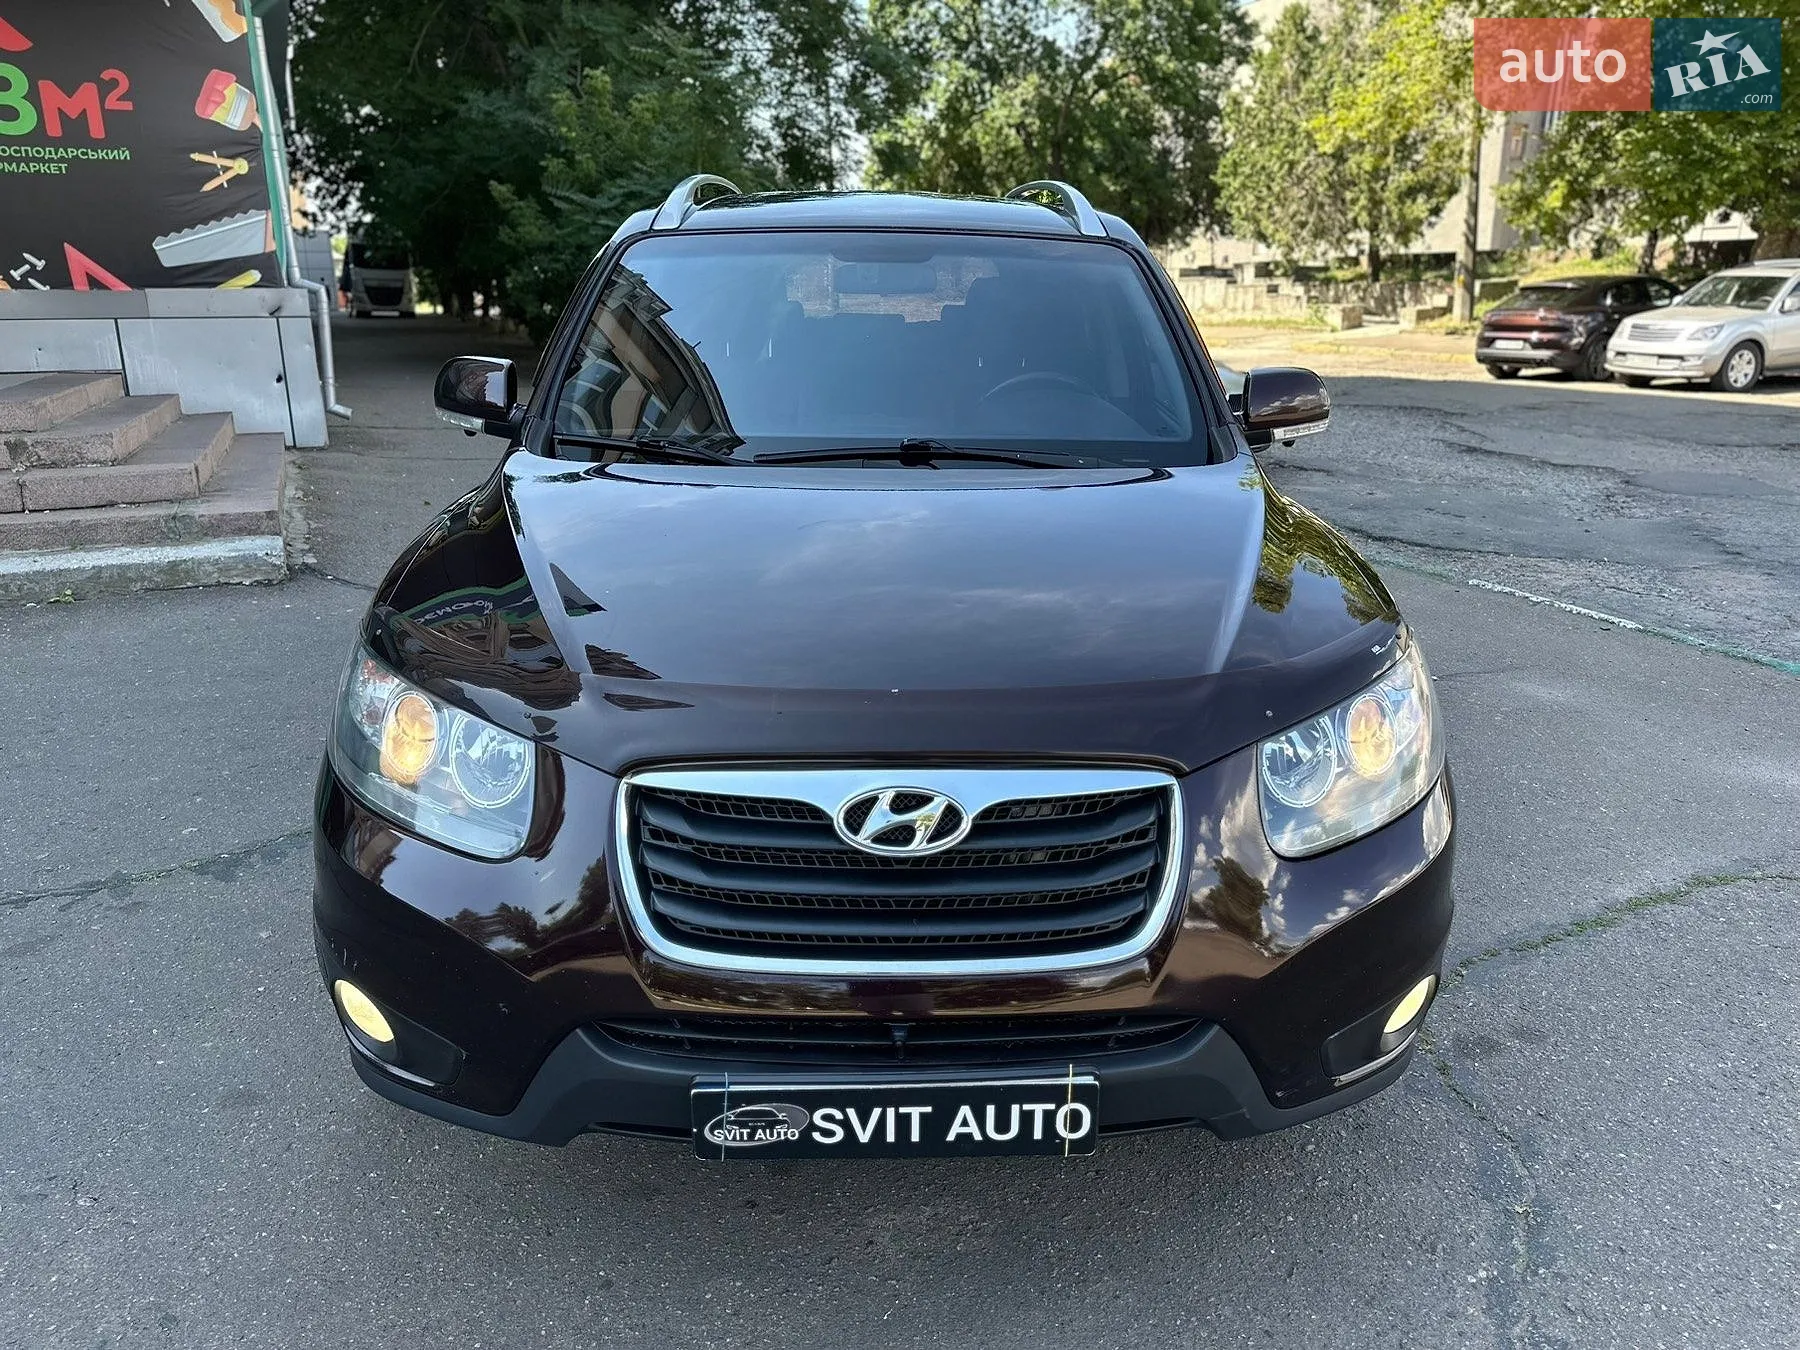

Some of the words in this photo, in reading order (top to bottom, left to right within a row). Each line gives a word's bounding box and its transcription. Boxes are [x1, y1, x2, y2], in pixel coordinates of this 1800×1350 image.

[713, 1128, 750, 1141] SVIT
[754, 1128, 799, 1140] AUTO
[811, 1105, 932, 1143] SVIT
[945, 1102, 1091, 1141] AUTO
